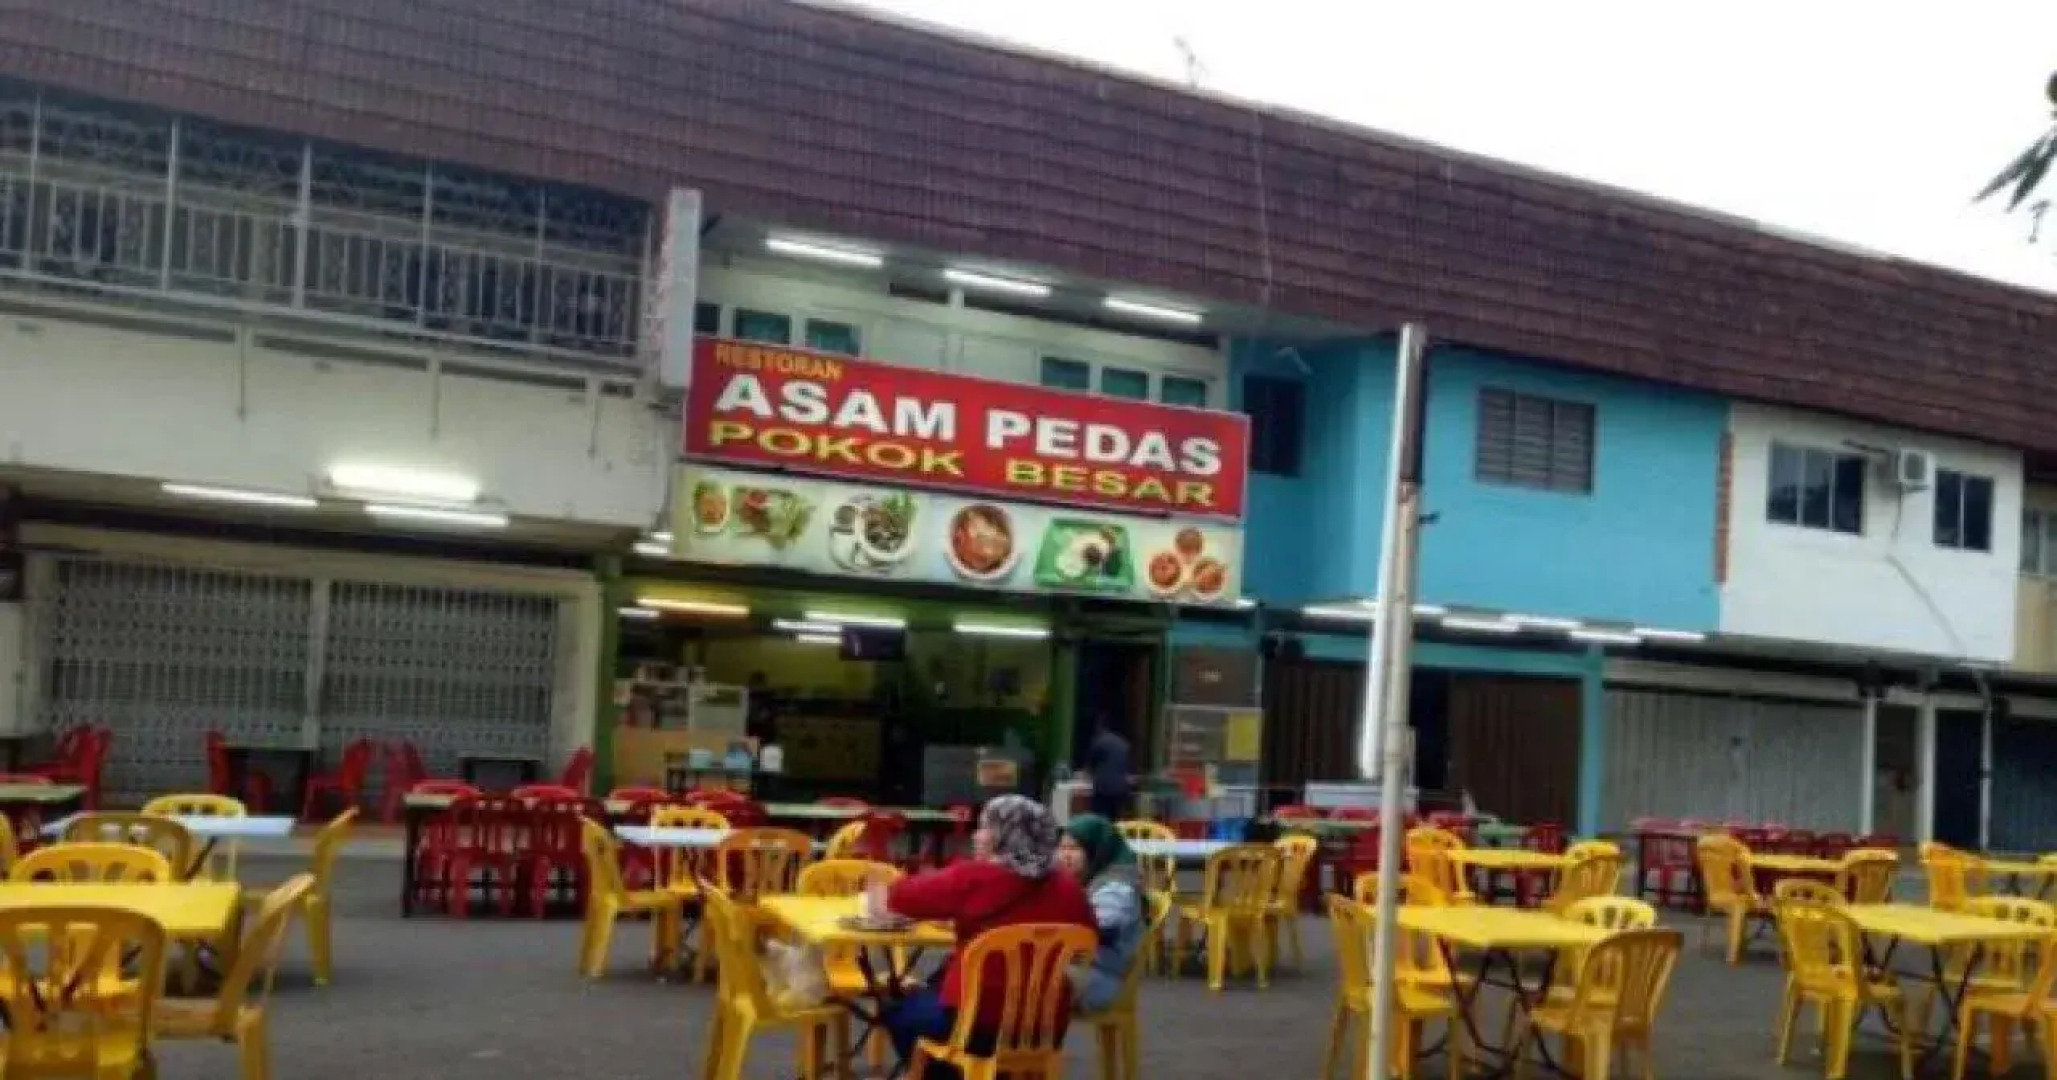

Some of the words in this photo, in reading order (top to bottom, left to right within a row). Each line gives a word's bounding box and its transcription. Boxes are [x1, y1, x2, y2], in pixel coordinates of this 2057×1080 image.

[716, 343, 842, 379] RESTORAN
[709, 420, 965, 477] POKOK
[1005, 458, 1217, 506] BESAR
[716, 373, 957, 440] ASAM
[986, 409, 1222, 475] PEDAS
